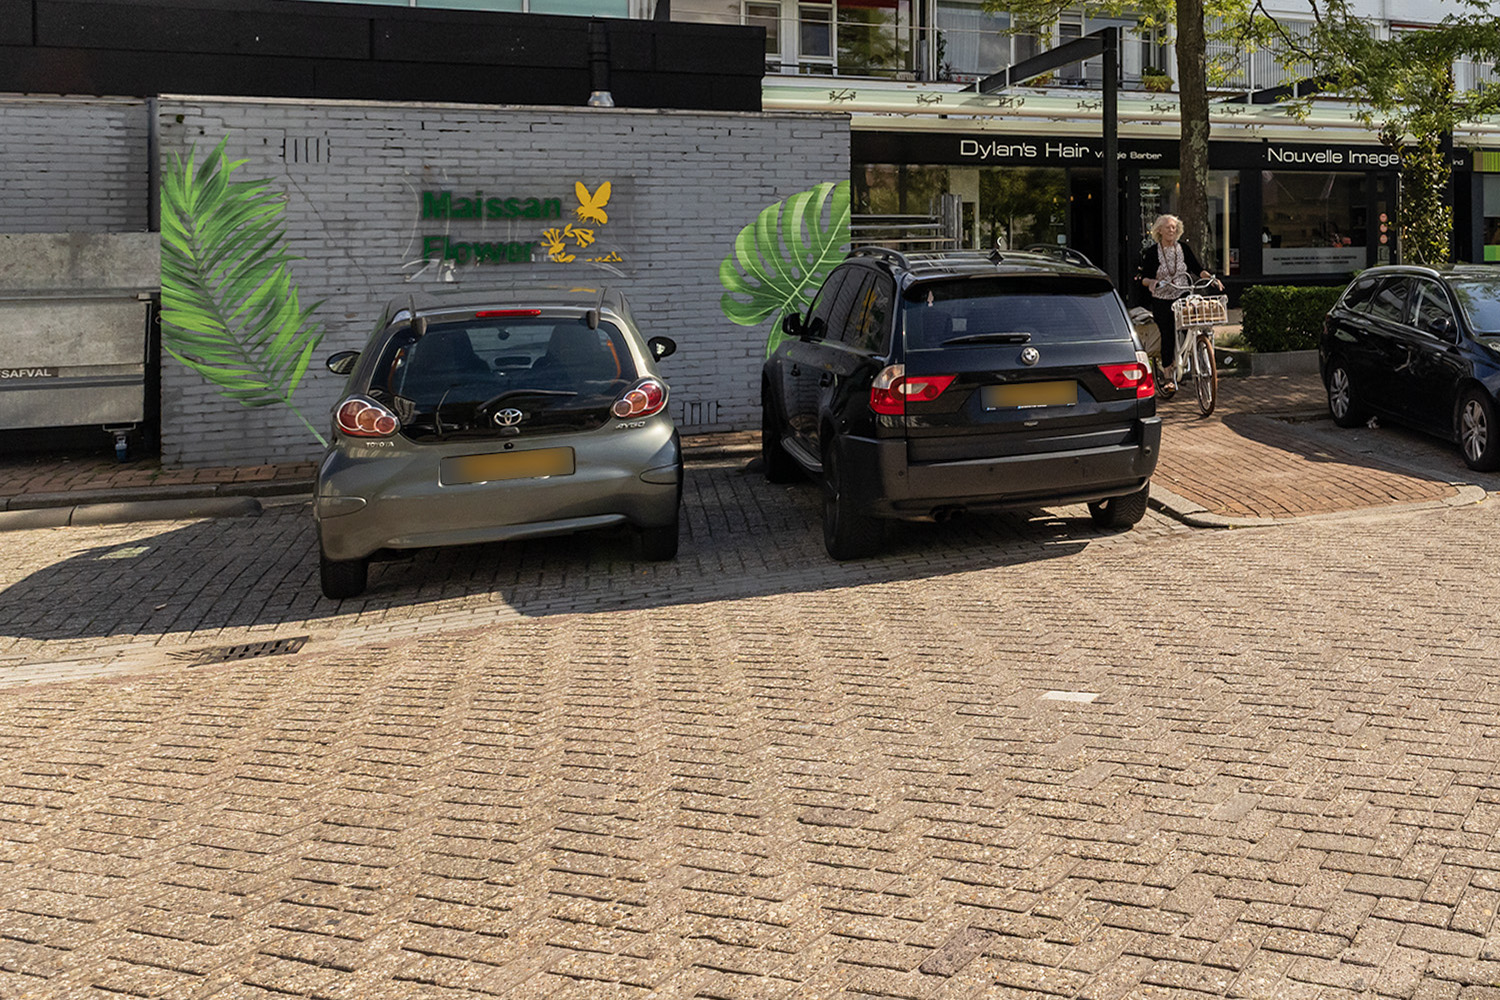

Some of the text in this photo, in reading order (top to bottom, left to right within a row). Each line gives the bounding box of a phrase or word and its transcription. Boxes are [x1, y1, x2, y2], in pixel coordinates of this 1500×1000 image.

[960, 140, 1037, 159] Dylan's
[1045, 142, 1090, 158] Hair
[1129, 151, 1163, 160] Barber
[1267, 147, 1400, 168] Nouvelle Image
[422, 190, 562, 220] Maissan
[423, 235, 538, 264] Flower
[0, 368, 52, 379] SAFVAL
